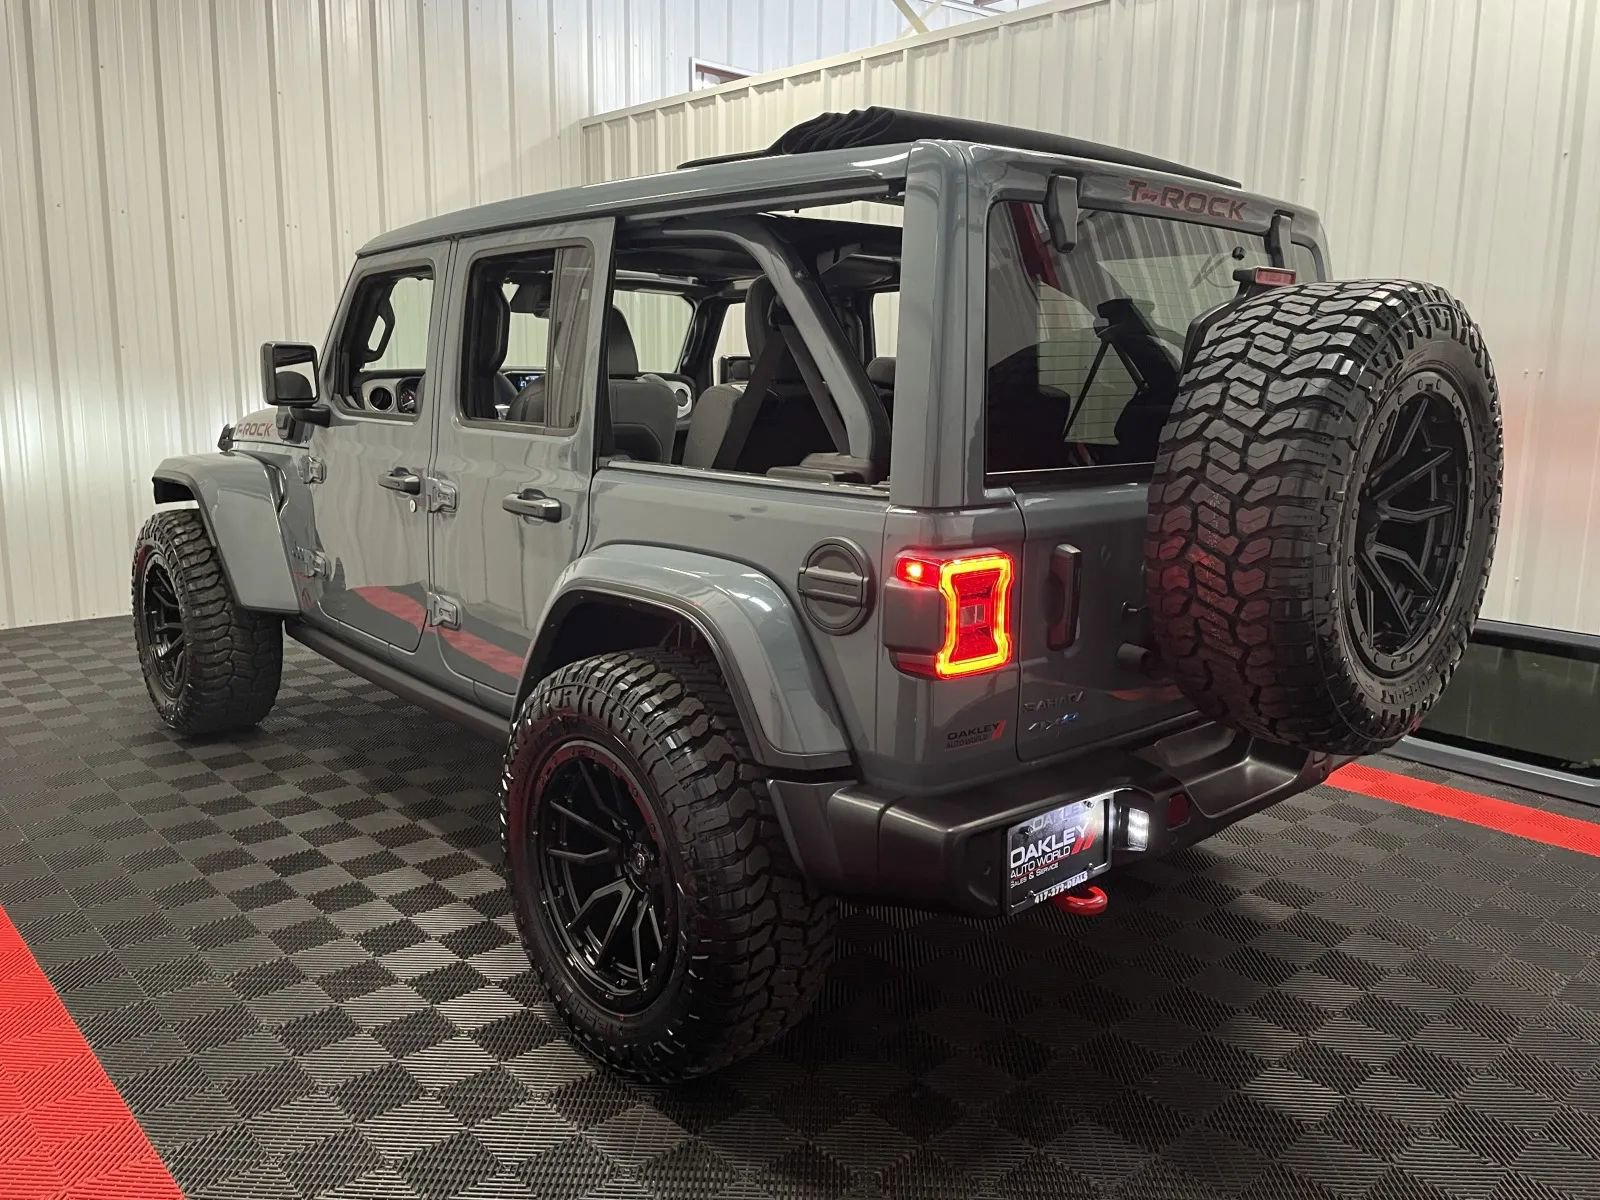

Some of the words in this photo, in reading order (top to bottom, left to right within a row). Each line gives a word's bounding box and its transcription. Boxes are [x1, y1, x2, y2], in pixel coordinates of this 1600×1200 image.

[947, 721, 1000, 740] OAKLEY
[1010, 822, 1090, 868] OAKLEY
[1010, 860, 1035, 879] AUTO
[1036, 845, 1071, 867] WORLD
[1028, 871, 1035, 880] &
